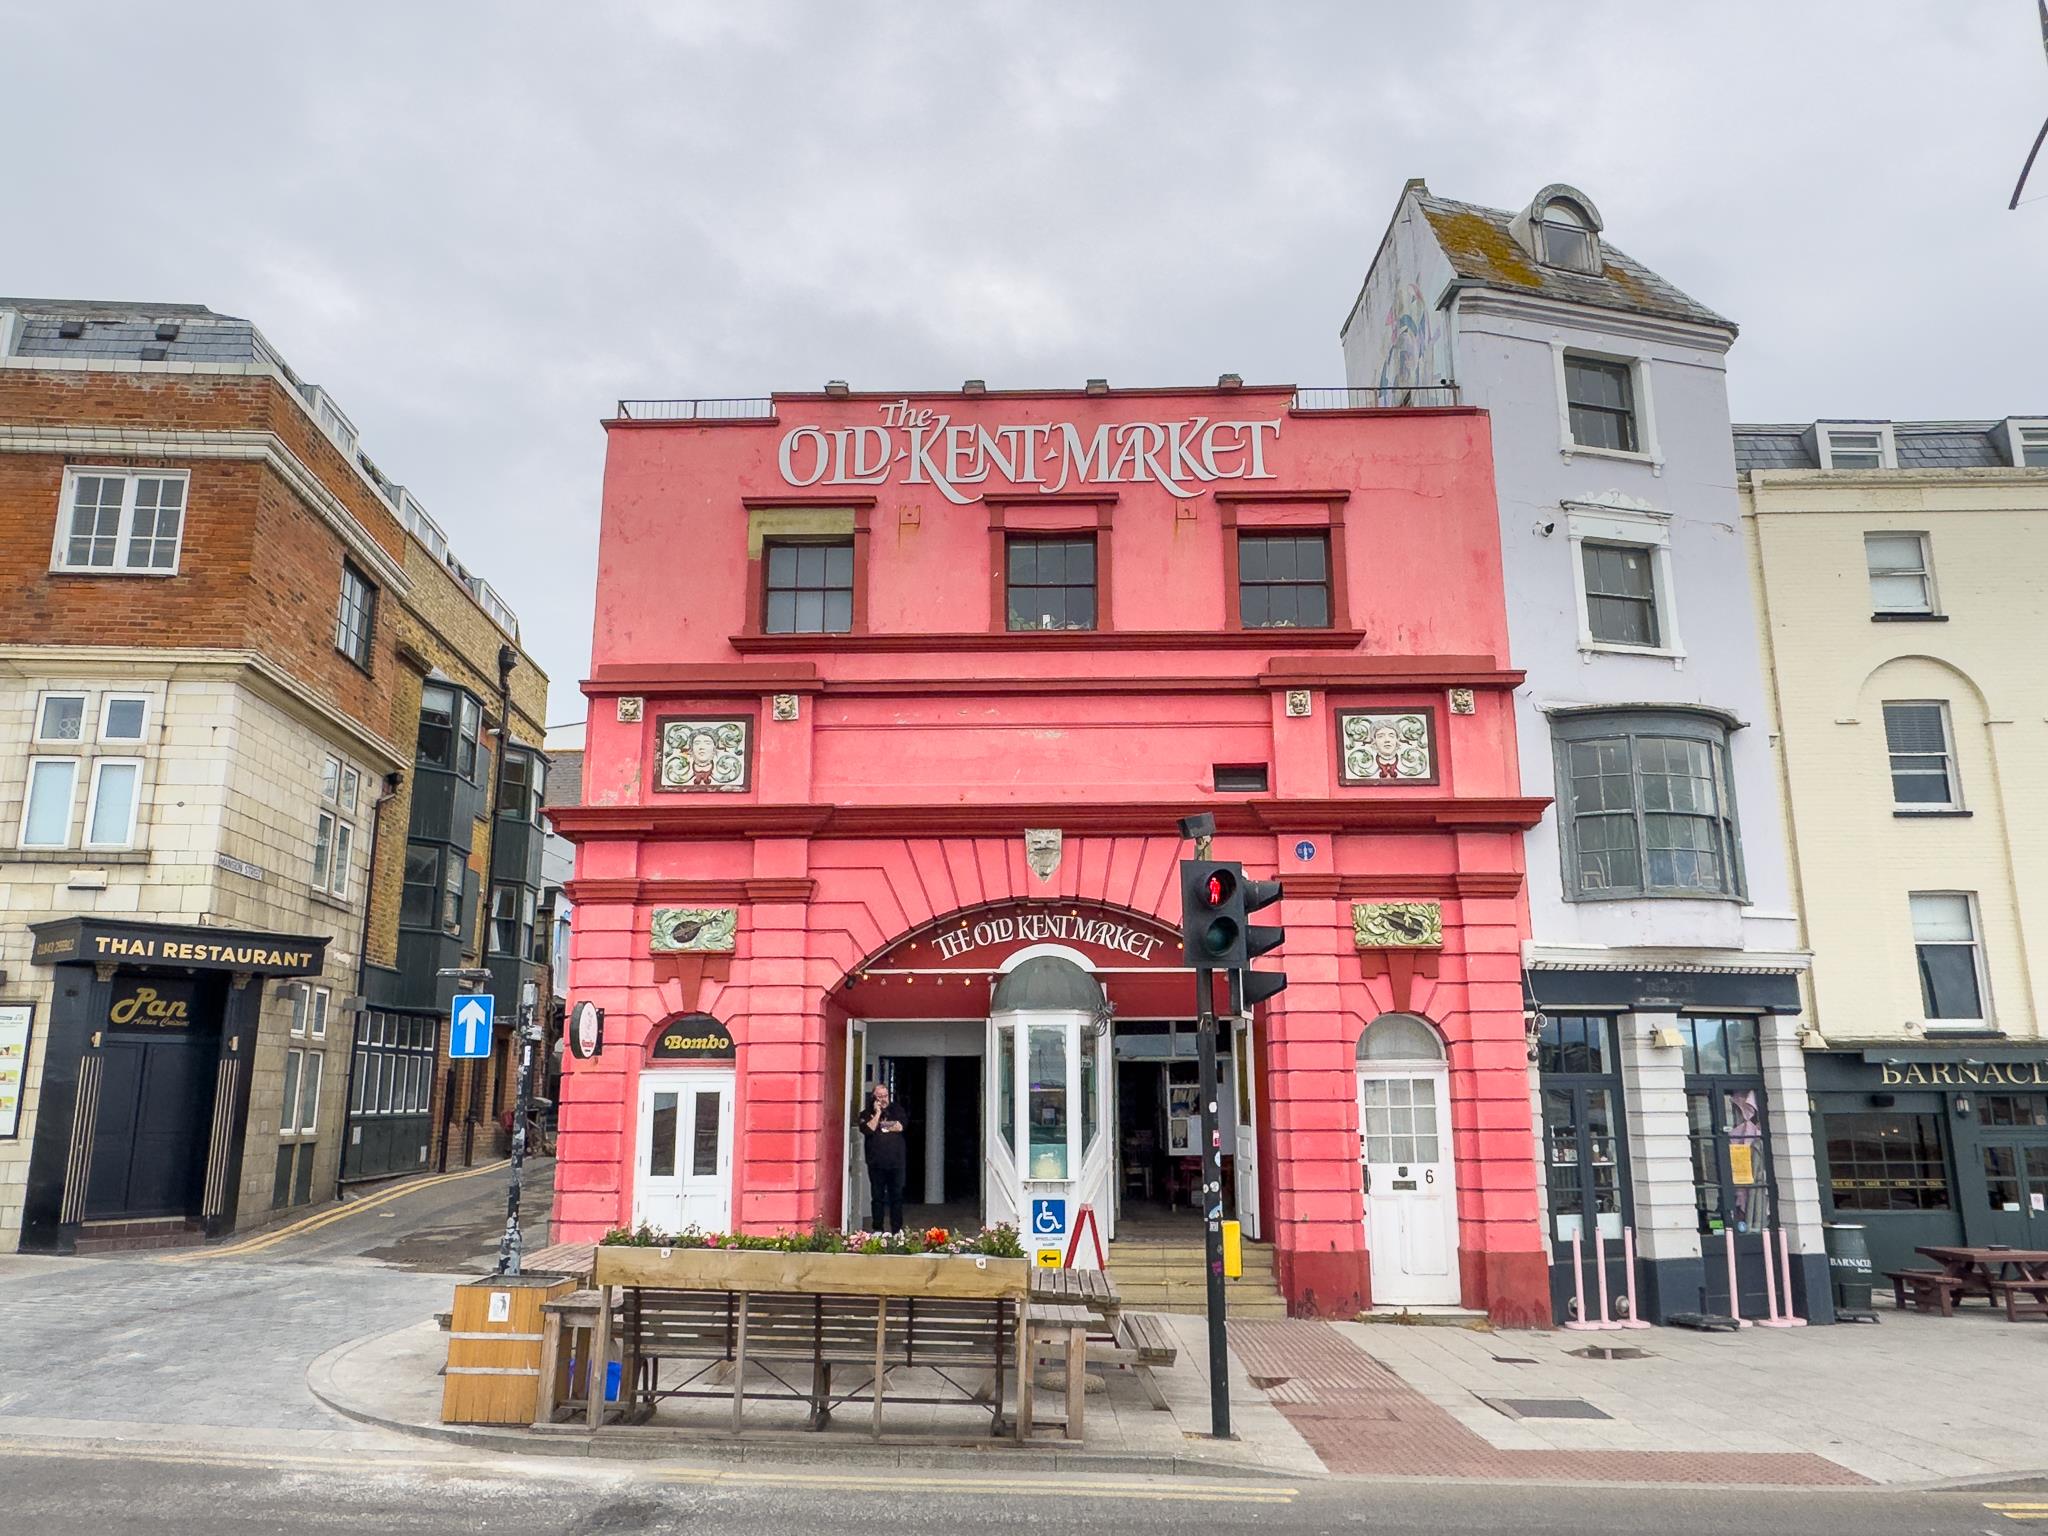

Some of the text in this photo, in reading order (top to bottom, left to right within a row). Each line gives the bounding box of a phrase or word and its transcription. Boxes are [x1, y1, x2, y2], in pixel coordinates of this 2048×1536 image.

[878, 399, 934, 428] The
[778, 415, 1282, 505] OLD KENT MARKET
[95, 936, 154, 957] THAI
[162, 942, 313, 968] RESTAURANT
[931, 914, 1164, 961] THE OLD KENT MARKET
[110, 987, 188, 1024] Pan
[664, 1034, 729, 1050] Bombo
[1425, 1169, 1434, 1184] 6
